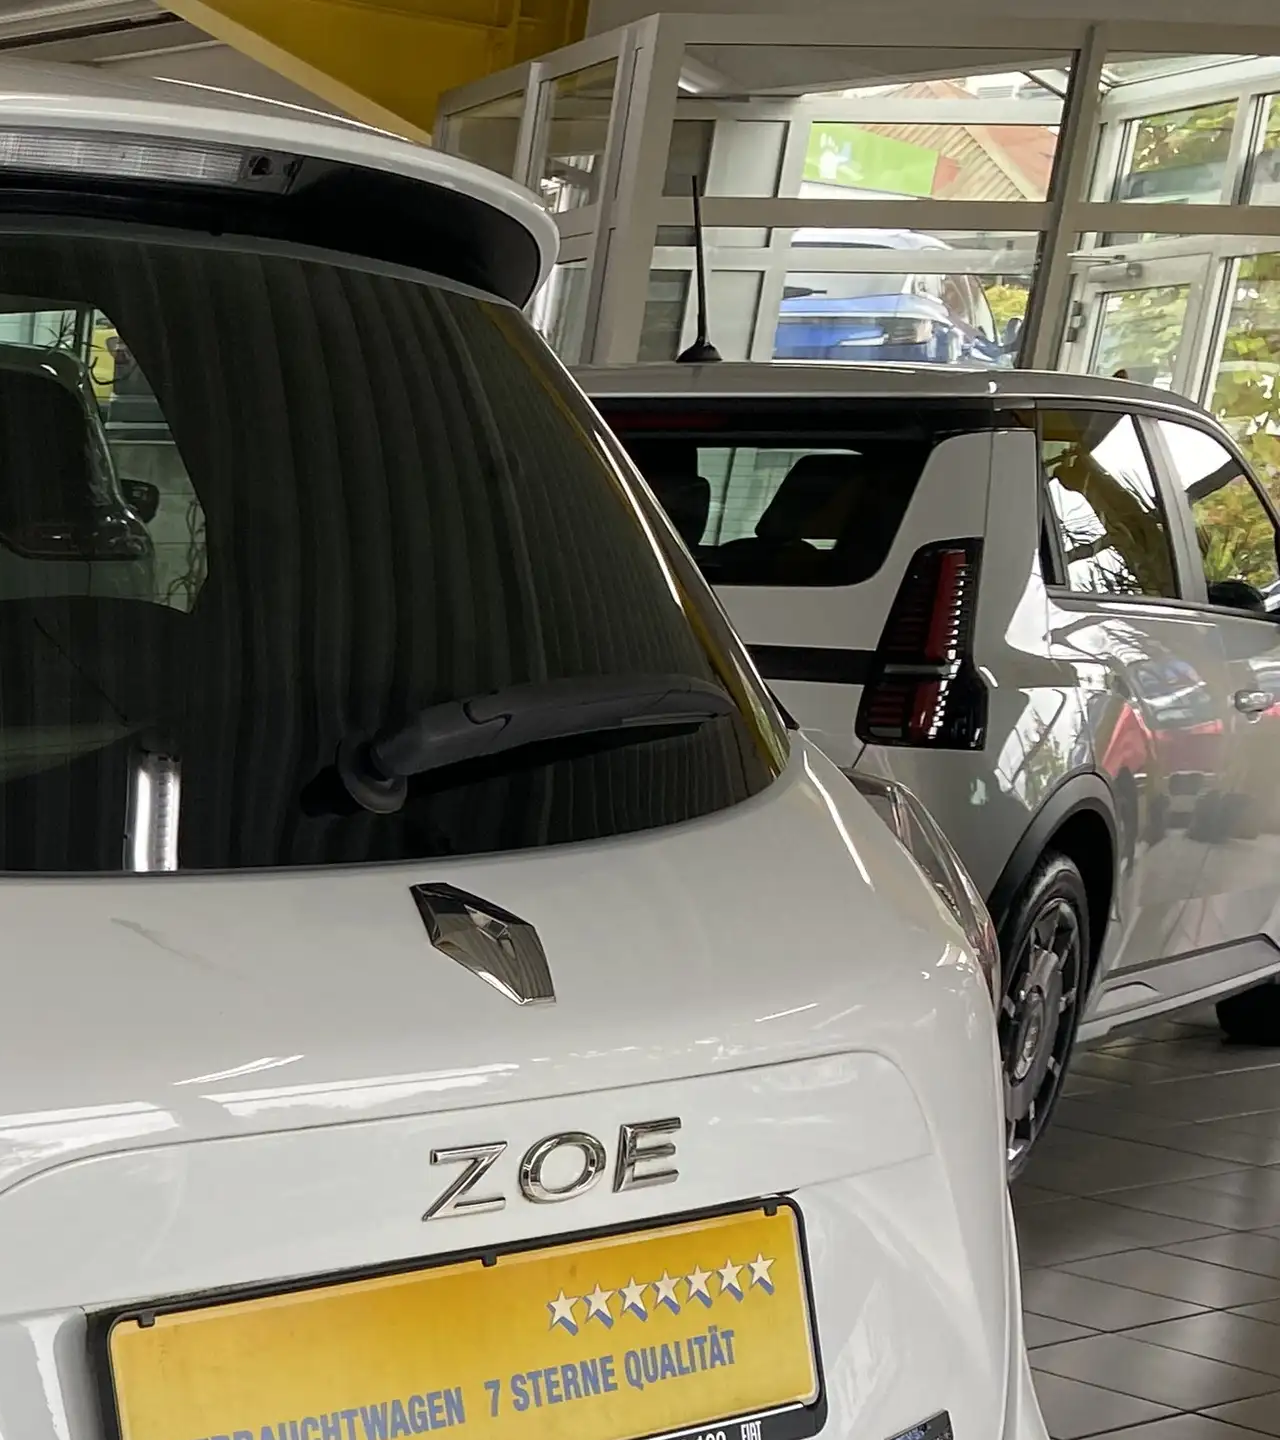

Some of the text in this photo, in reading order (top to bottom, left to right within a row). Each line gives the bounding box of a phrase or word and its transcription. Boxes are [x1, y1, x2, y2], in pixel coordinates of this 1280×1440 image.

[421, 1116, 682, 1222] ZOE
[484, 1379, 501, 1418] 7
[510, 1355, 618, 1412] STERNE
[624, 1324, 735, 1391] QUALITÄT
